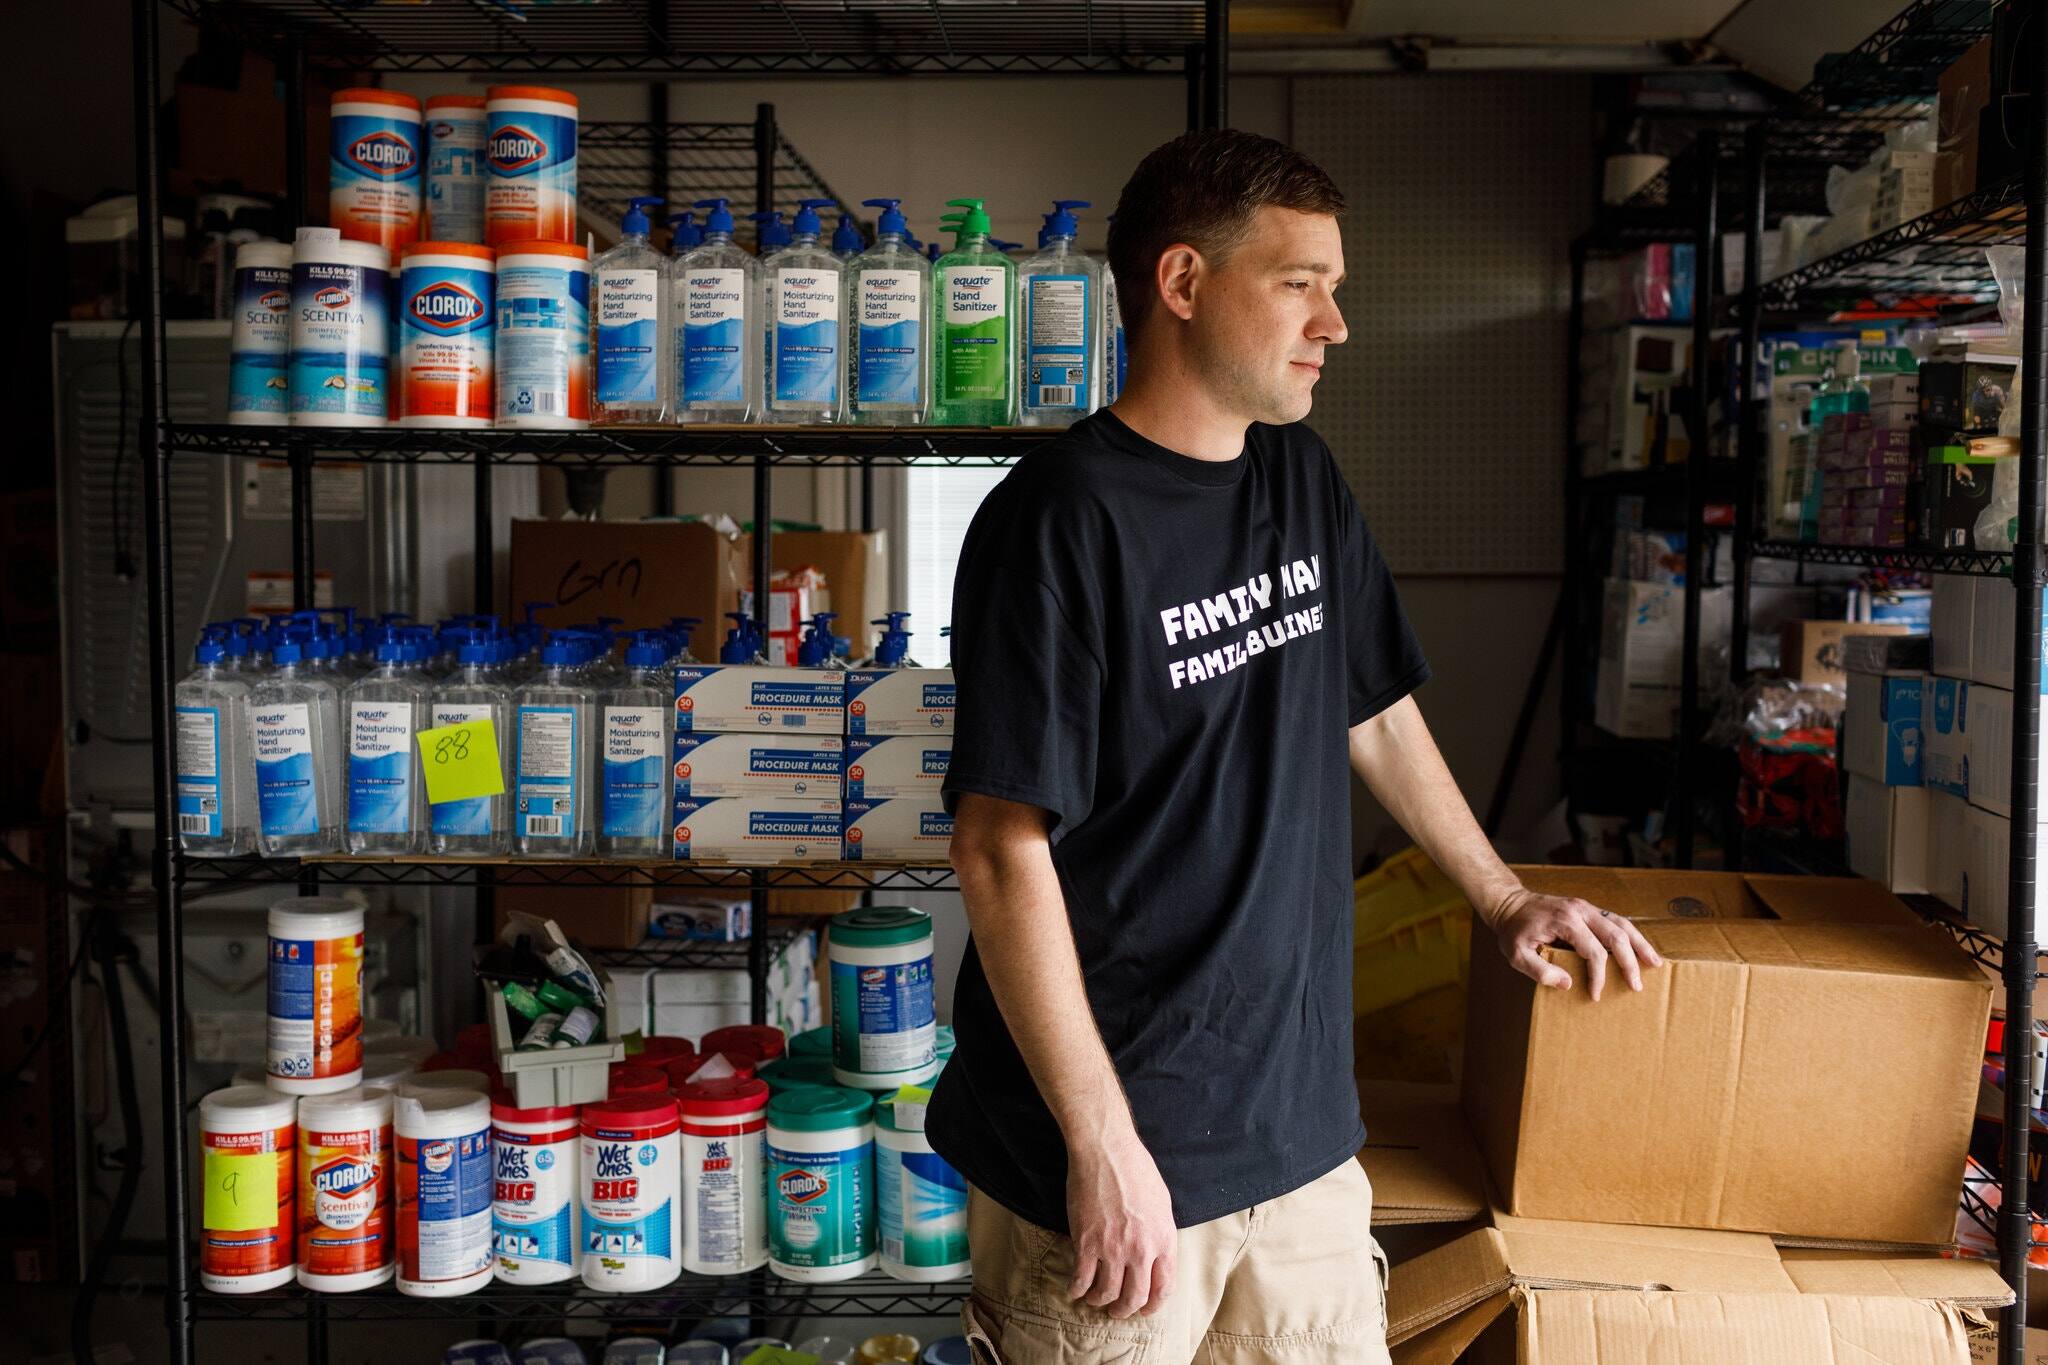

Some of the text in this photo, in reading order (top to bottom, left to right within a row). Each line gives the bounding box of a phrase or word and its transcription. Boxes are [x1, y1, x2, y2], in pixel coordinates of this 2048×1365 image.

[355, 142, 411, 166] CLOROX
[487, 139, 537, 159] CLOROX
[255, 270, 278, 280] KILLS
[309, 266, 333, 275] KILLS
[603, 277, 634, 287] equate
[690, 277, 721, 287] equate
[783, 277, 817, 287] equate
[865, 277, 897, 287] equate
[953, 275, 991, 287] equate
[318, 293, 347, 305] CLOROX
[603, 292, 653, 302] Moisturizing
[689, 292, 740, 301] Moisturizing
[783, 291, 834, 302] Moisturizing
[865, 293, 916, 302] Moisturizing
[953, 291, 980, 301] Hand
[416, 295, 476, 318] CLOROX
[603, 302, 624, 310] Hand
[783, 301, 806, 309] Hand
[952, 302, 998, 312] Sanitizer
[246, 311, 289, 325] SCENT
[302, 308, 364, 325] SCENTIVA
[603, 311, 638, 319] Sanitizer
[690, 311, 725, 319] Sanitizer
[783, 310, 820, 319] Sanitizer
[865, 312, 901, 320] Sanitizer
[416, 343, 453, 351] Disinfecting
[1802, 350, 1897, 365] CHPIN
[1160, 573, 1272, 646] FAMIY
[1169, 641, 1248, 690] FAMIL
[680, 698, 692, 707] 50
[753, 693, 842, 705] PROCEDURE MASK
[925, 695, 956, 705] PROCE
[852, 703, 865, 711] 50
[256, 713, 286, 724] equate
[356, 710, 388, 720] equate
[437, 712, 469, 722] equate
[609, 714, 642, 724] equate
[257, 727, 305, 737] Moisturizing
[356, 724, 407, 734] Moisturizing
[609, 729, 660, 739] Moisturizing
[258, 738, 278, 746] Hand
[356, 734, 378, 742] Hand
[609, 738, 632, 746] Hand
[259, 746, 292, 756] Sanitizer
[355, 743, 391, 751] Sanitizer
[434, 729, 471, 765] 88
[609, 747, 645, 756] Sanitizer
[678, 766, 689, 774] 50
[752, 760, 839, 771] PROCEDURE MASK
[851, 768, 863, 776] 50
[677, 829, 689, 837] 50
[752, 823, 839, 833] PROCEDURE MASK
[923, 823, 954, 833] PROCE
[849, 830, 861, 838] 50
[215, 1134, 262, 1144] KILLS 99.9%
[321, 1133, 369, 1143] KILLS 99.9%
[706, 1141, 727, 1151] Wet
[498, 1146, 529, 1165] Wet
[598, 1143, 632, 1163] Wet
[706, 1149, 728, 1159] Ones
[596, 1160, 633, 1177] Ones
[702, 1157, 732, 1173] BIG
[498, 1163, 529, 1179] Ones
[316, 1162, 375, 1192] CLOROX
[593, 1179, 639, 1201] BIG
[780, 1177, 821, 1195] CLOROX
[495, 1182, 536, 1201] BIG
[320, 1200, 369, 1211] Scentiva
